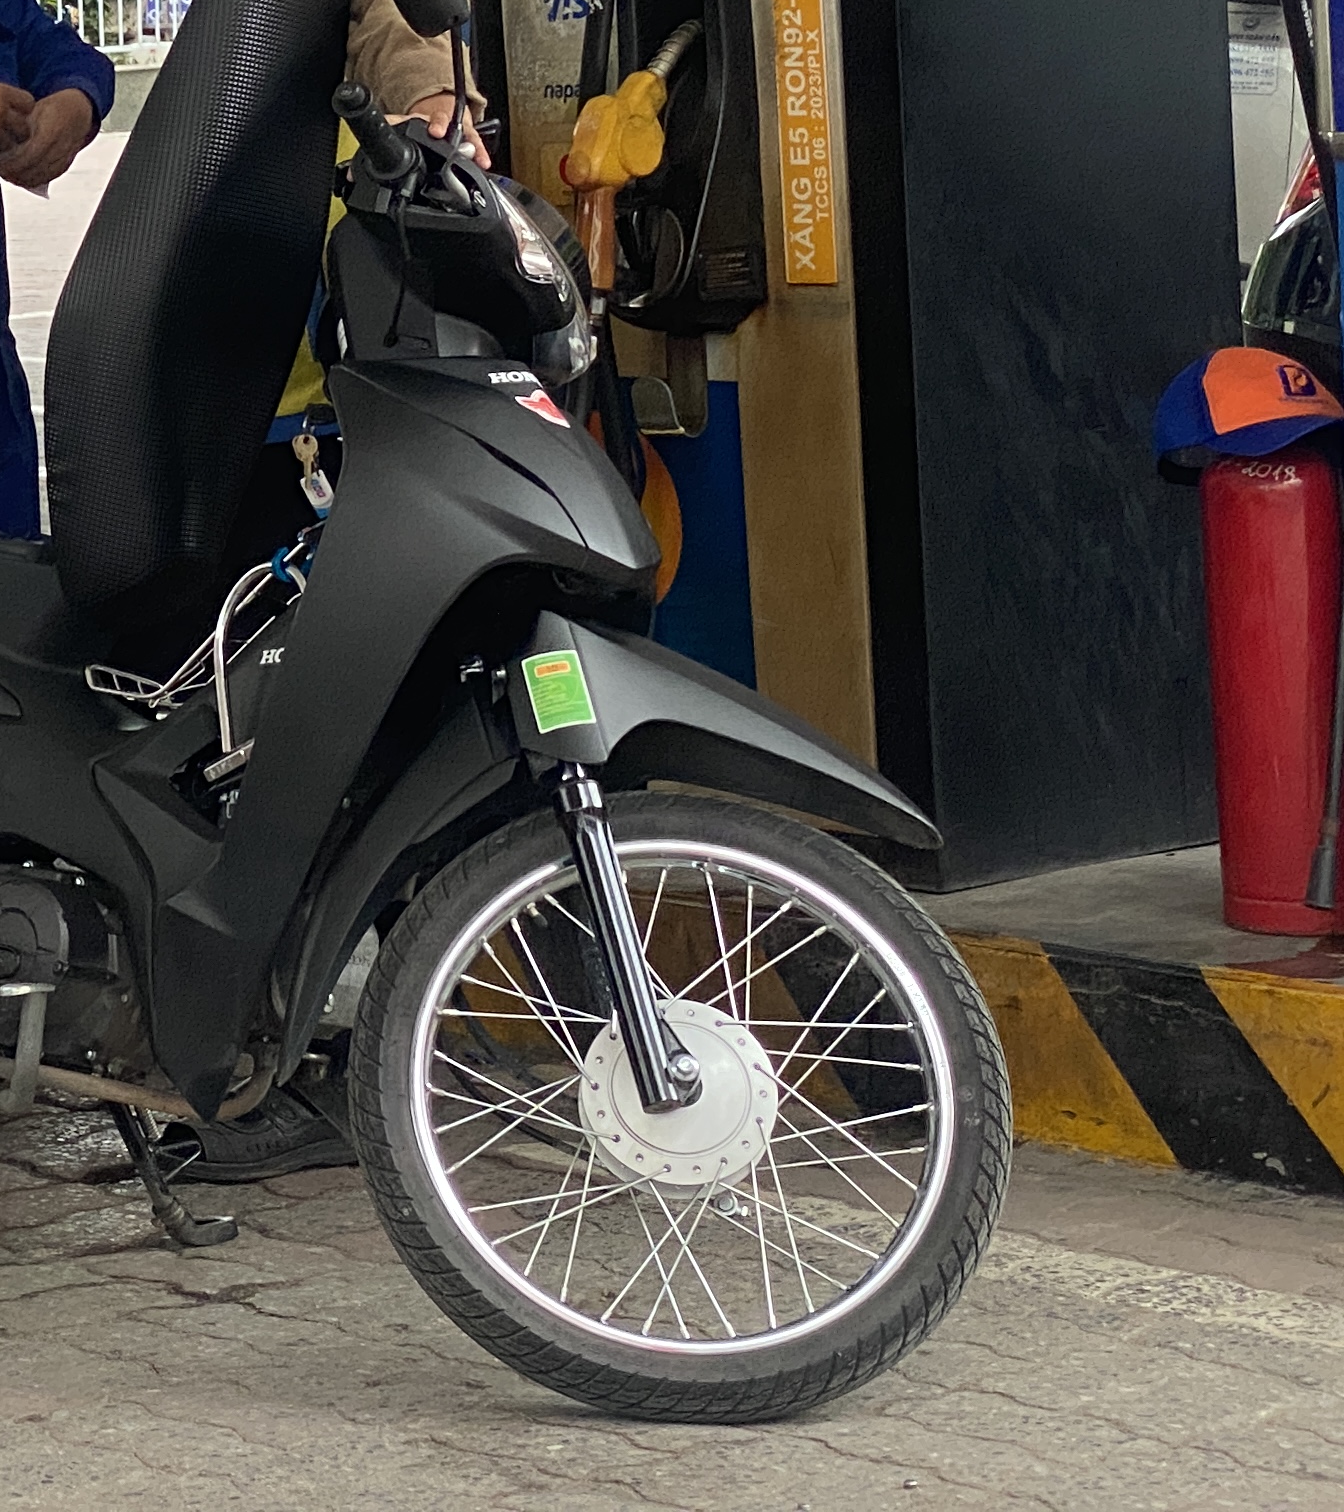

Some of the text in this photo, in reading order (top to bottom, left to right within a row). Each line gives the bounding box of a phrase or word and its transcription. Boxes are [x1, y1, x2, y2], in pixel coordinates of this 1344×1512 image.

[788, 128, 811, 166] E5
[806, 28, 830, 221] TCCS 06 2023/PLX
[790, 177, 816, 270] XĂNG
[1241, 462, 1297, 481] 2018
